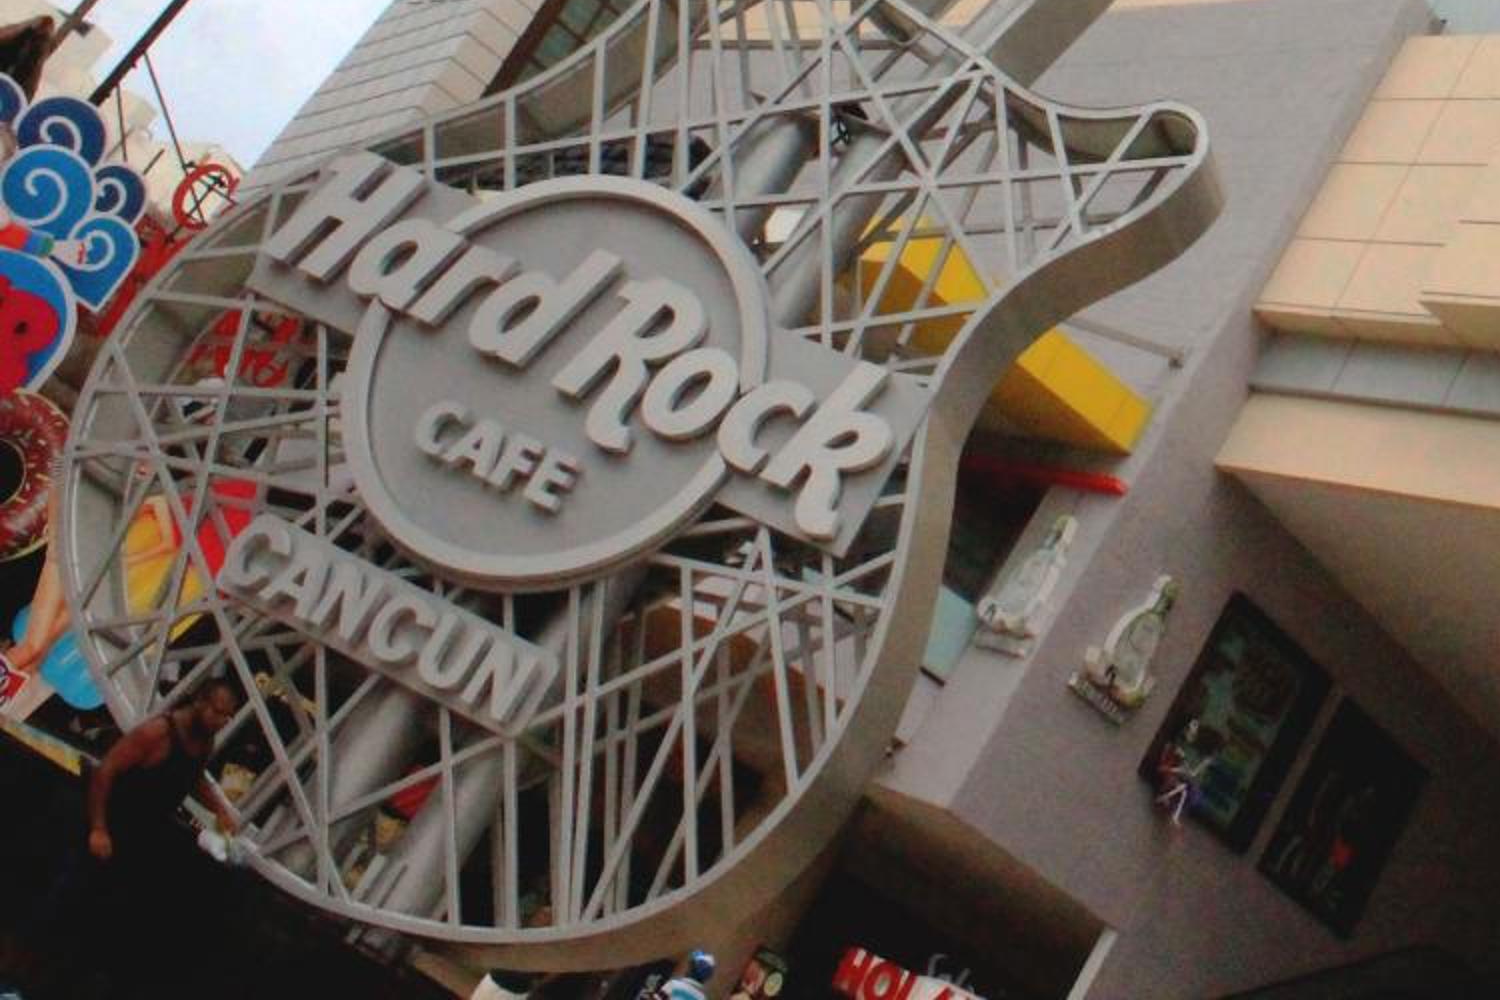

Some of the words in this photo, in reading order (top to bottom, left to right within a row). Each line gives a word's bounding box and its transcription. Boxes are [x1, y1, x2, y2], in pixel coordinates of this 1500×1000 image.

[266, 148, 622, 368] Hard
[551, 276, 895, 540] Rock
[415, 402, 585, 514] CAFE
[218, 513, 560, 724] CANCUN
